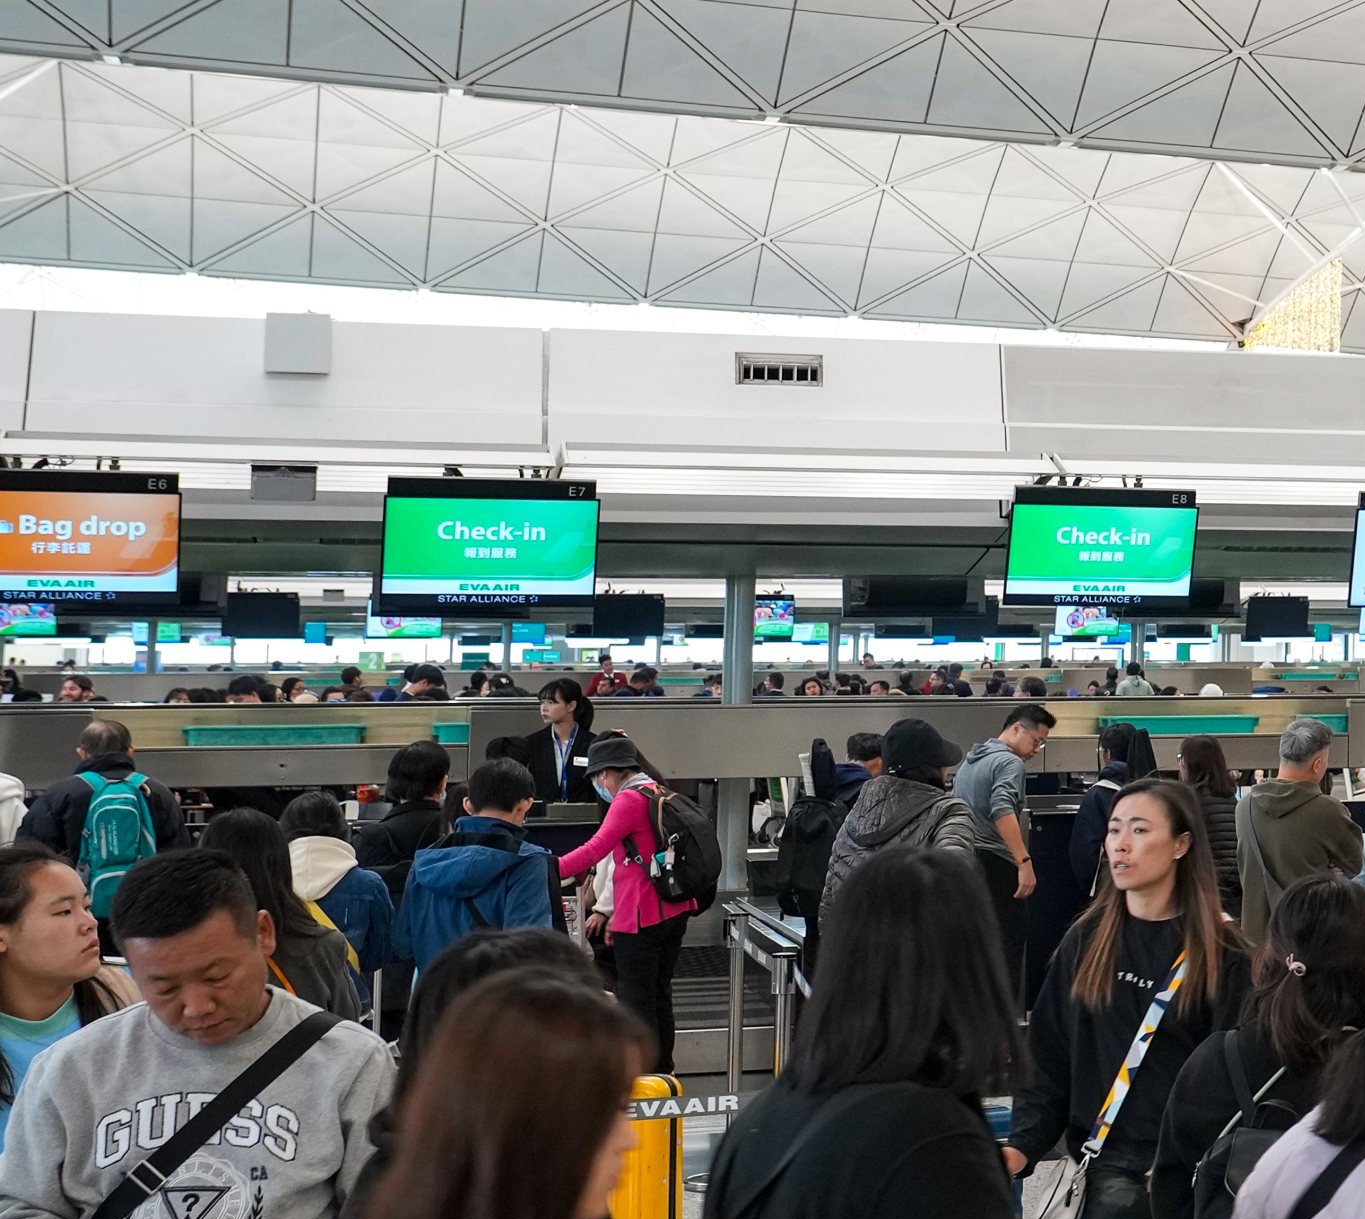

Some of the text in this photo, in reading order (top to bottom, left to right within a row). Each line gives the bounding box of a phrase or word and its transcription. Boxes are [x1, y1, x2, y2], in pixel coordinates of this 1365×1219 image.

[148, 478, 168, 490] E6
[568, 486, 586, 496] E7
[1172, 494, 1188, 504] E8
[19, 514, 146, 540] Bag drop
[437, 521, 546, 541] Check-in
[1056, 527, 1150, 546] Check-in
[464, 548, 517, 559] 報到服務
[3, 592, 102, 600] STAR ALLIANCE
[438, 595, 526, 604] STAR ALLIANCE
[1054, 595, 1130, 604] STAR ALLIANCE
[250, 1166, 268, 1180] CA
